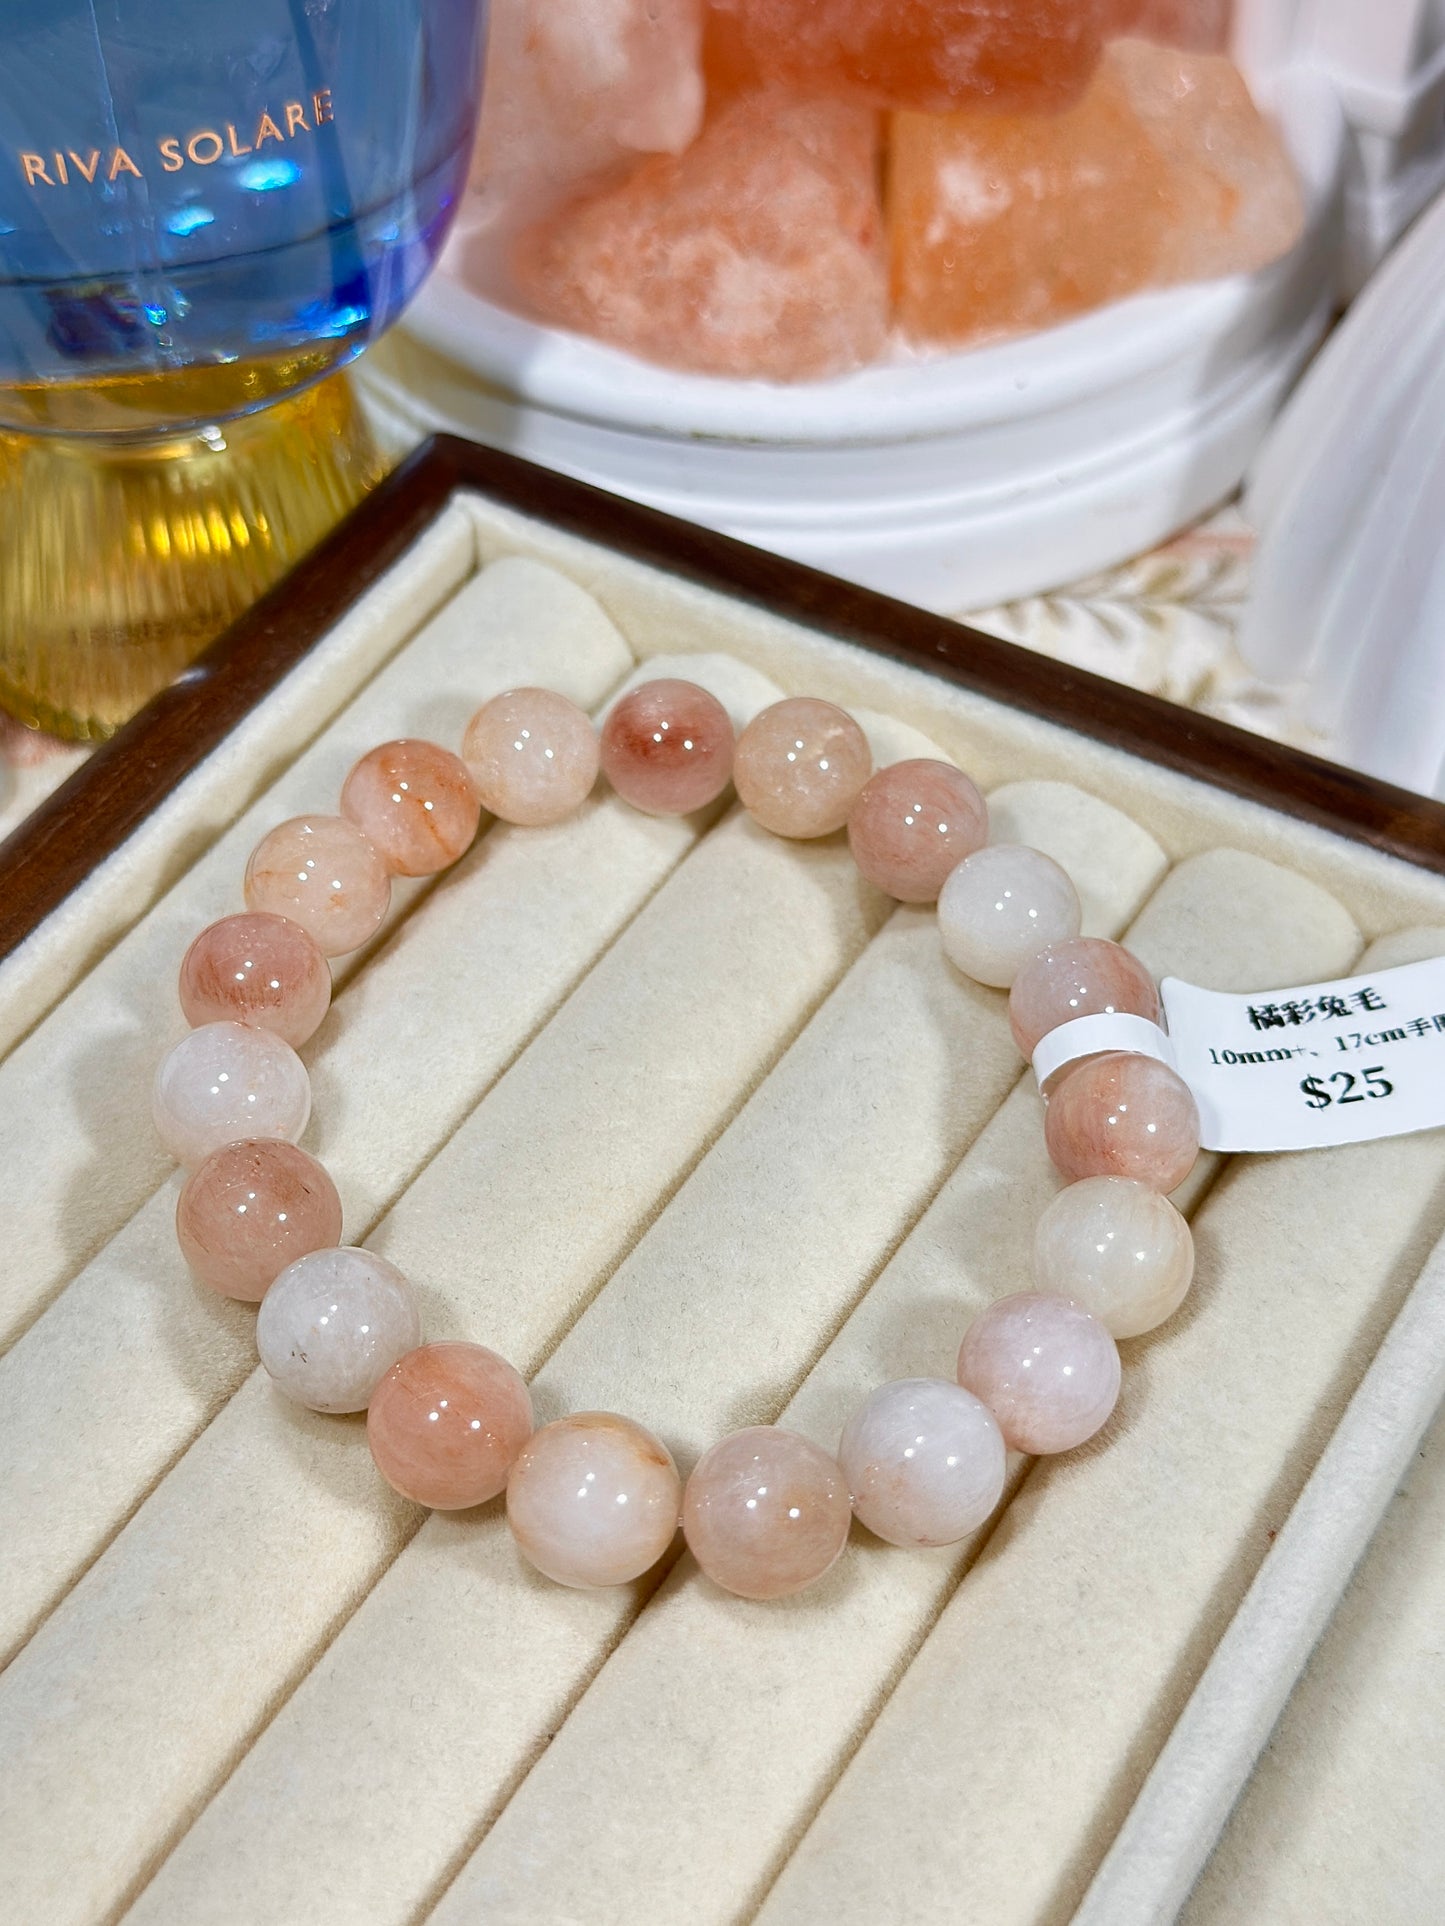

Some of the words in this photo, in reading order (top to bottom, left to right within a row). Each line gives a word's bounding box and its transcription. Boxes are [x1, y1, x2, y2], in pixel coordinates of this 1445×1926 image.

[21, 148, 143, 186] RIVA
[160, 89, 335, 172] SOLARE
[1246, 987, 1387, 1031] 橘彩兔毛
[1300, 1065, 1394, 1112] $25
